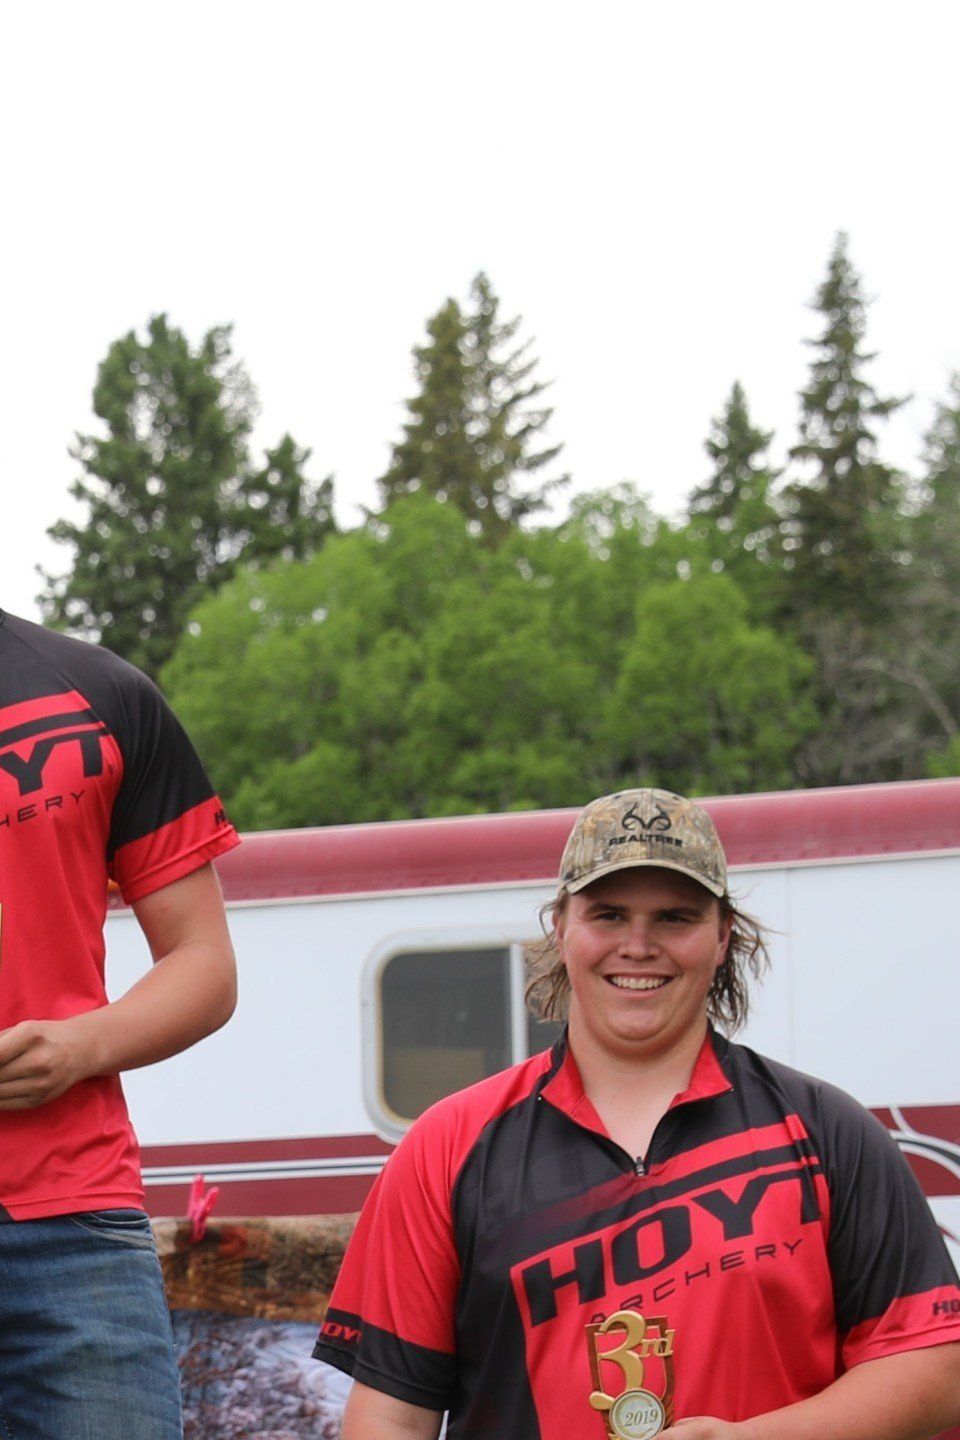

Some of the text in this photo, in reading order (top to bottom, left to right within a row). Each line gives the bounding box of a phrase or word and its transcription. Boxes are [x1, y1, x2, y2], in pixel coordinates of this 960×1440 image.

[608, 834, 683, 848] REALTREE
[522, 1168, 822, 1328] HOYT
[624, 1408, 659, 1427] 2019
